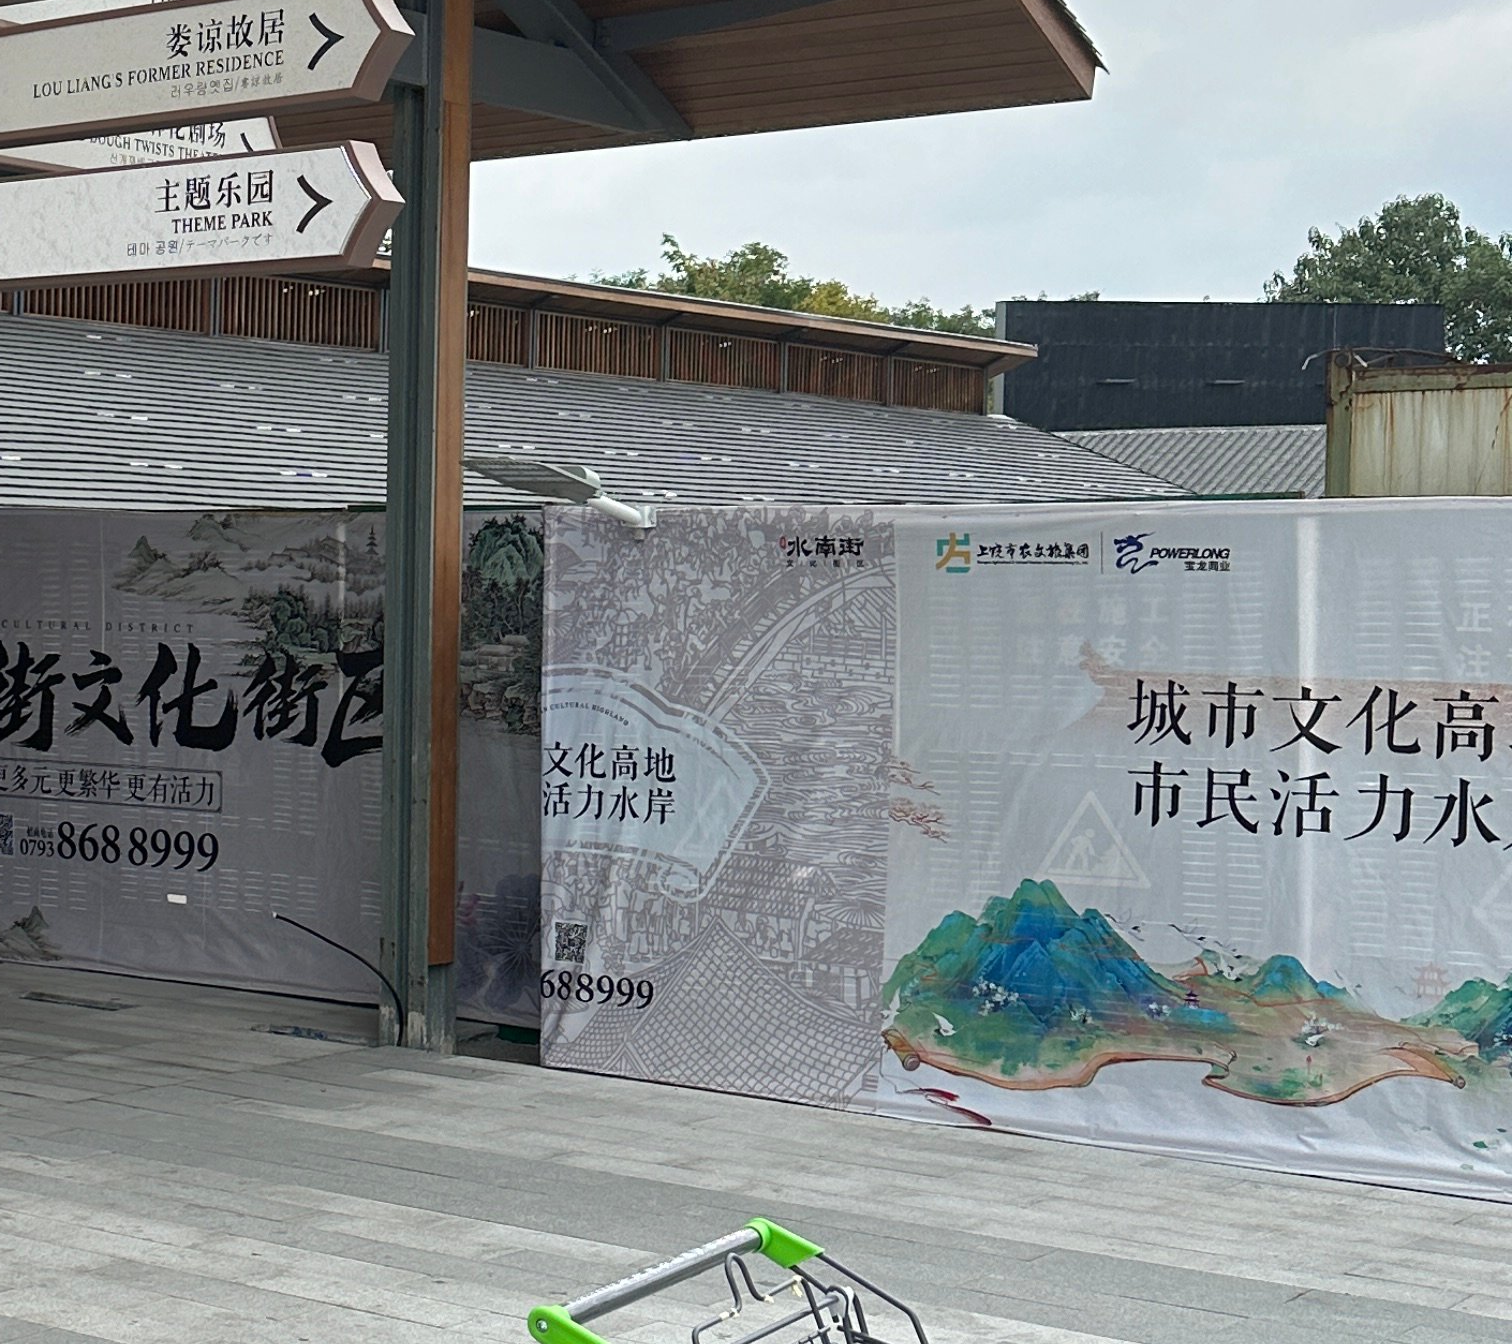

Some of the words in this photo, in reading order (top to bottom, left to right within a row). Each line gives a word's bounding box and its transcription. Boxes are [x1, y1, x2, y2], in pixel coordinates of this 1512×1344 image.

[166, 8, 286, 60] 娄谅故居
[32, 80, 63, 99] LOU
[66, 72, 123, 95] LIANG'S
[128, 62, 192, 87] FORMER
[195, 49, 285, 77] RESIDENCE
[134, 138, 175, 158] TWISTS
[154, 169, 274, 214] 主题乐园
[171, 214, 227, 235] THEME
[231, 210, 273, 232] PARK
[786, 535, 864, 559] 水南街
[1150, 547, 1231, 559] POWERLONG
[1, 619, 91, 631] CULTURAL
[105, 622, 195, 634] DISTRICT
[1126, 678, 1512, 762] 城市文化高
[542, 741, 677, 783] 文化高地
[126, 773, 215, 806] 更有活力
[543, 781, 676, 825] 活力水岸
[1126, 760, 1512, 851] 市民活力水
[19, 838, 55, 857] 0793
[56, 820, 121, 864] 868
[127, 826, 220, 872] 8999
[540, 969, 654, 1010] 688999
